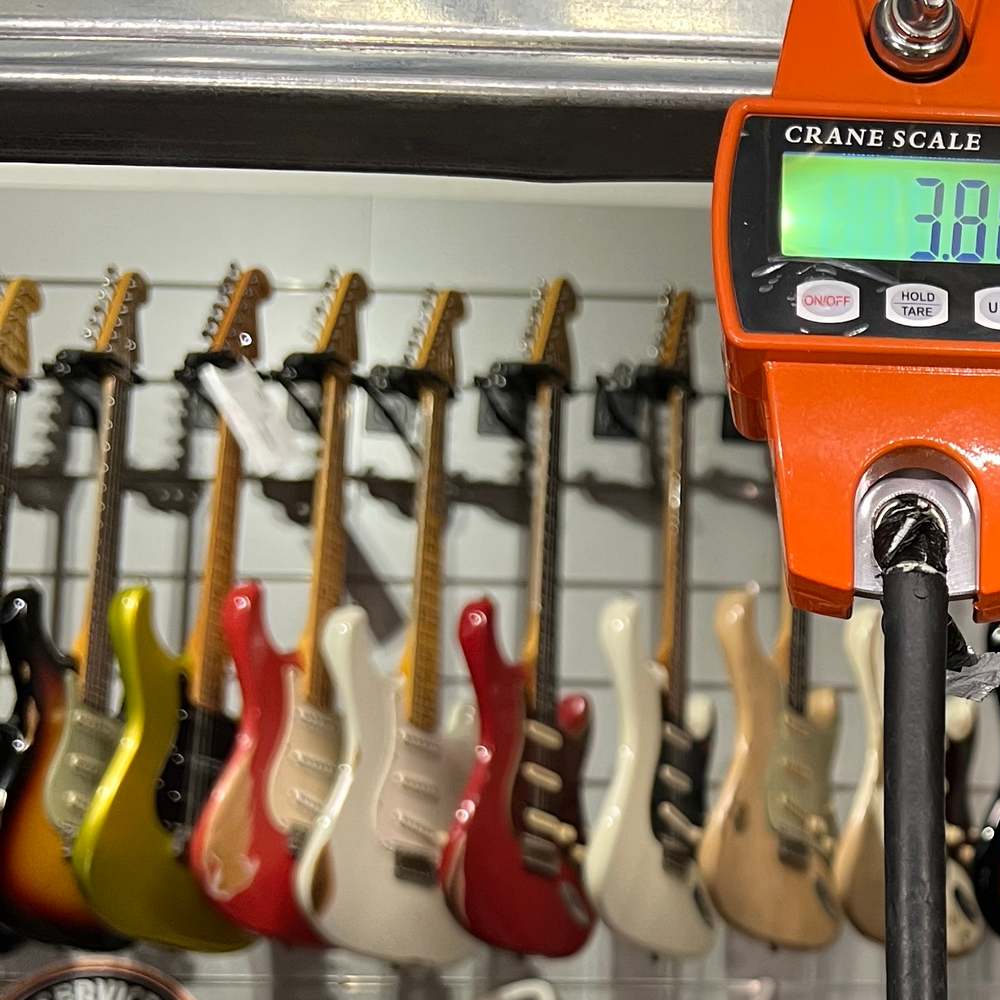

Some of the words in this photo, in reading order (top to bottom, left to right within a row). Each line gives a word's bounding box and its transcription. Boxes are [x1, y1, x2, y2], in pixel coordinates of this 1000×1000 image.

[785, 125, 884, 147] CRANE
[892, 130, 981, 150] SCALE
[803, 293, 851, 306] ON/OFF
[901, 291, 935, 302] HOLD
[902, 306, 933, 317] TARE
